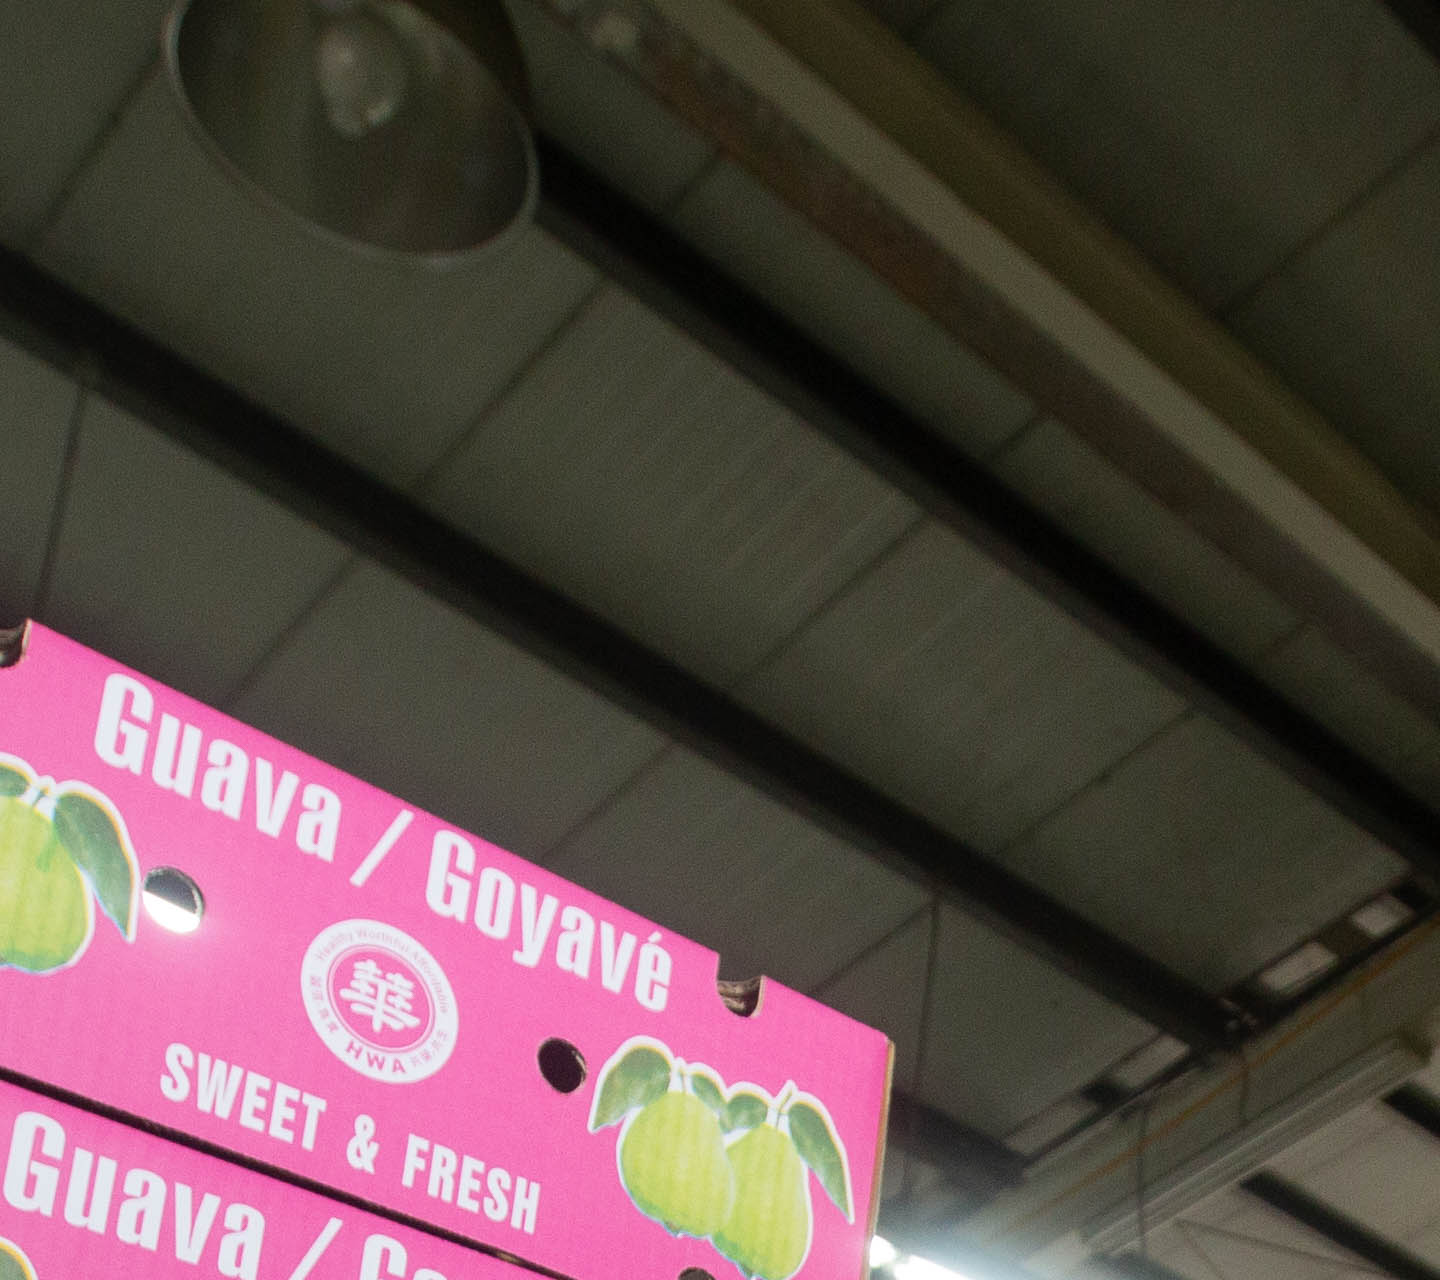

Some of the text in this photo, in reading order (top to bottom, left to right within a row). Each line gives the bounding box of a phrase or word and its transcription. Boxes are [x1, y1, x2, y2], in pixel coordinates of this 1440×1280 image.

[94, 674, 339, 862] Guava
[426, 829, 674, 1012] Goyavé
[339, 959, 421, 1033] 華
[346, 1041, 407, 1074] HWA
[160, 1043, 540, 1234] SWEET & FRESH
